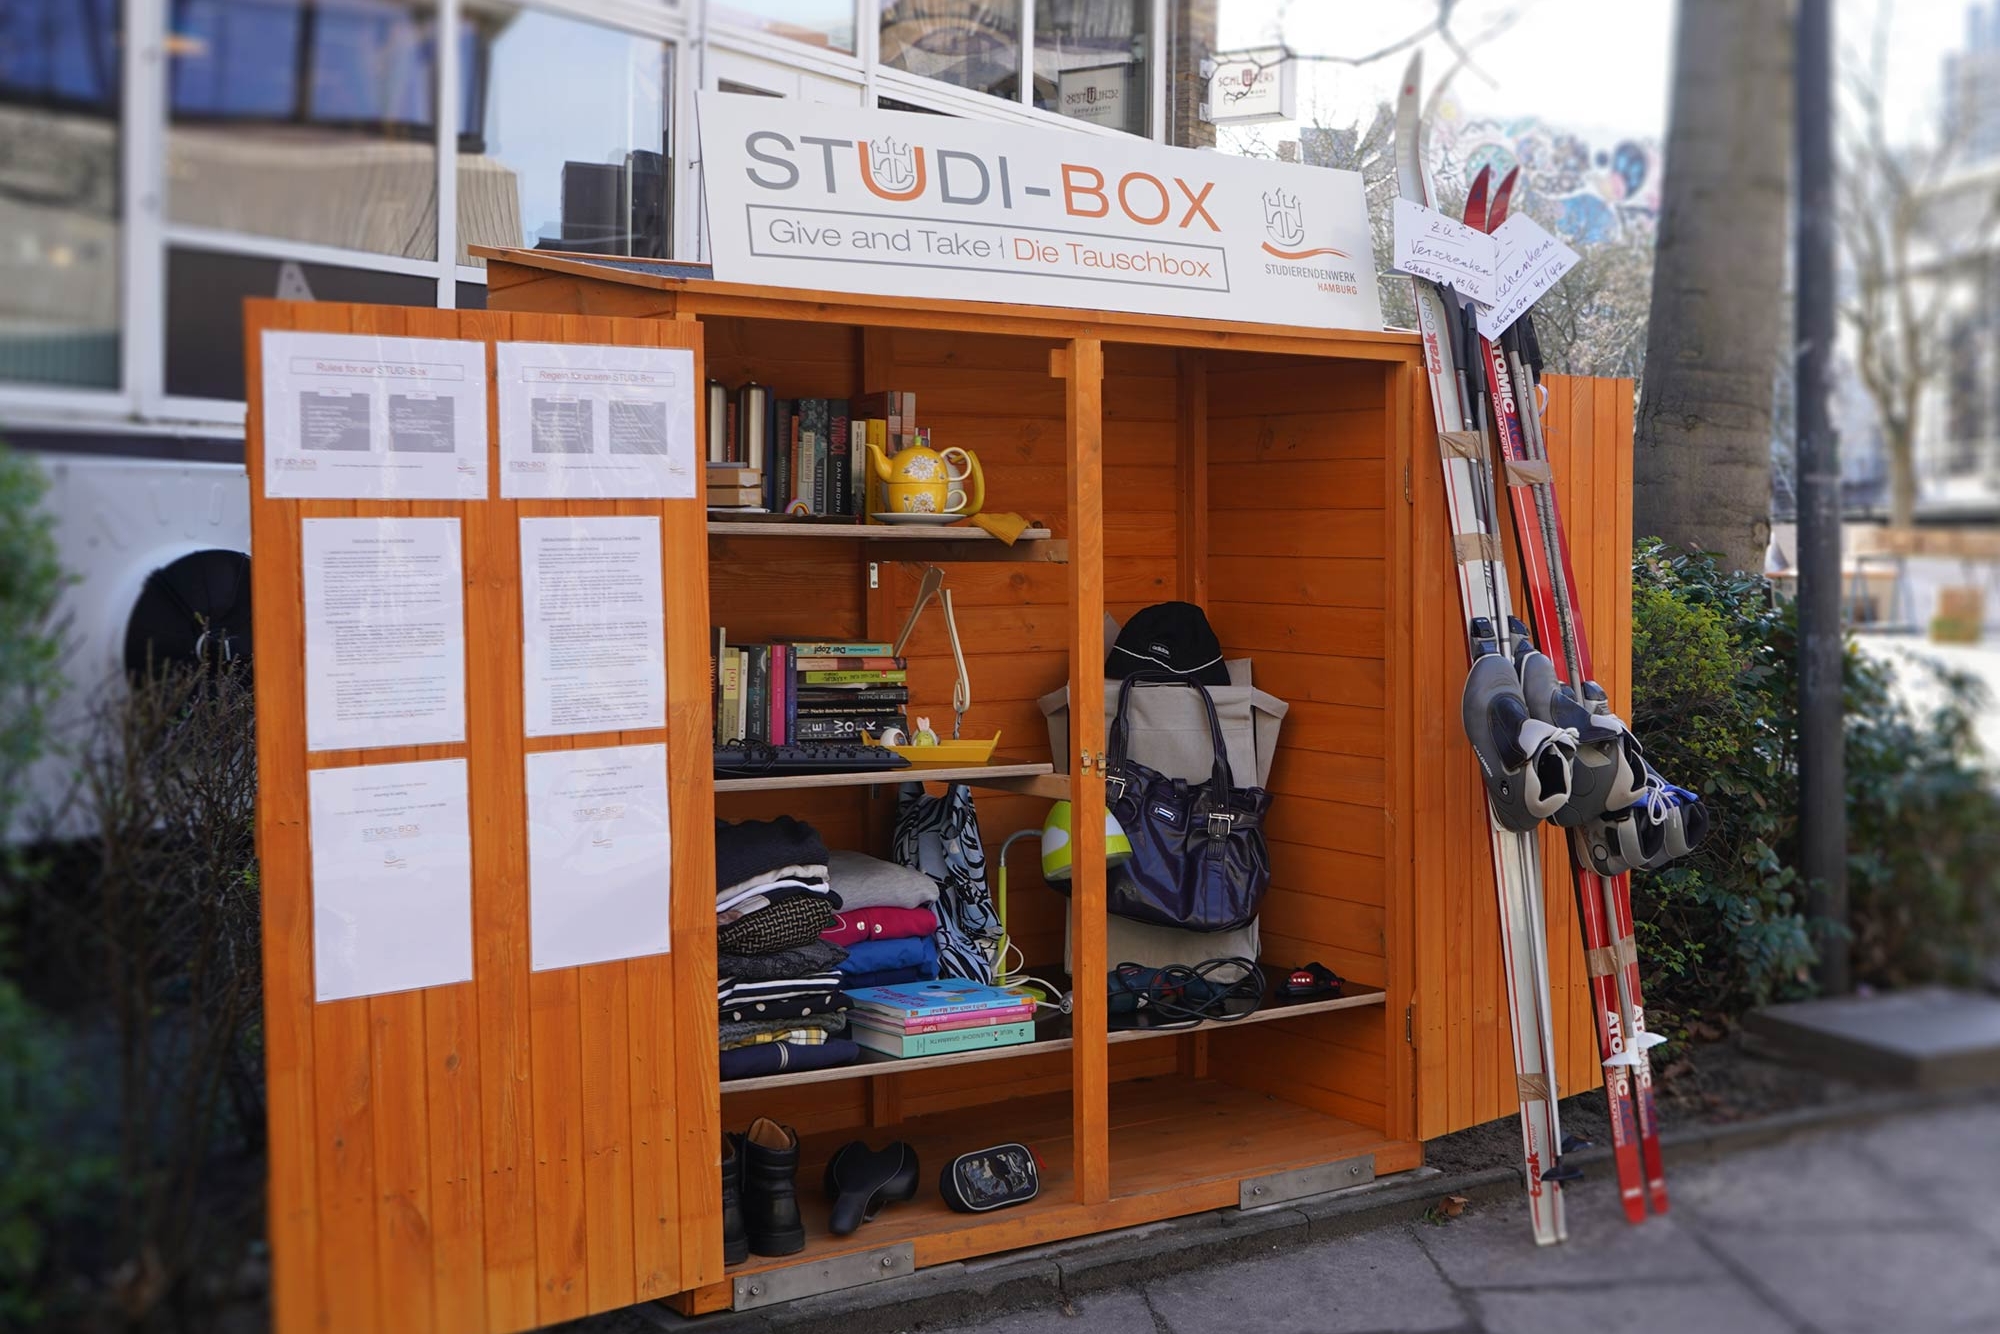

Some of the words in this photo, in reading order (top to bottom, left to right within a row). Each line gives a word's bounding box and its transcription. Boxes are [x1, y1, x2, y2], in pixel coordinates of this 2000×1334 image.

[744, 130, 1222, 233] STUDI-BOX
[768, 218, 842, 250] Give
[851, 227, 912, 253] and
[917, 228, 991, 257] Take
[1014, 237, 1059, 265] Die
[1065, 240, 1213, 279] Tauschbox
[1264, 262, 1357, 285] STUDIERENDENWERK
[1316, 280, 1358, 297] HAMBURG
[1425, 332, 1443, 376] trak
[316, 362, 344, 374] Rules
[830, 415, 848, 457] SYMBOL
[813, 645, 831, 655] Zopf
[833, 646, 846, 655] Der
[921, 1024, 938, 1033] TOPP
[1527, 1151, 1542, 1198] trak
